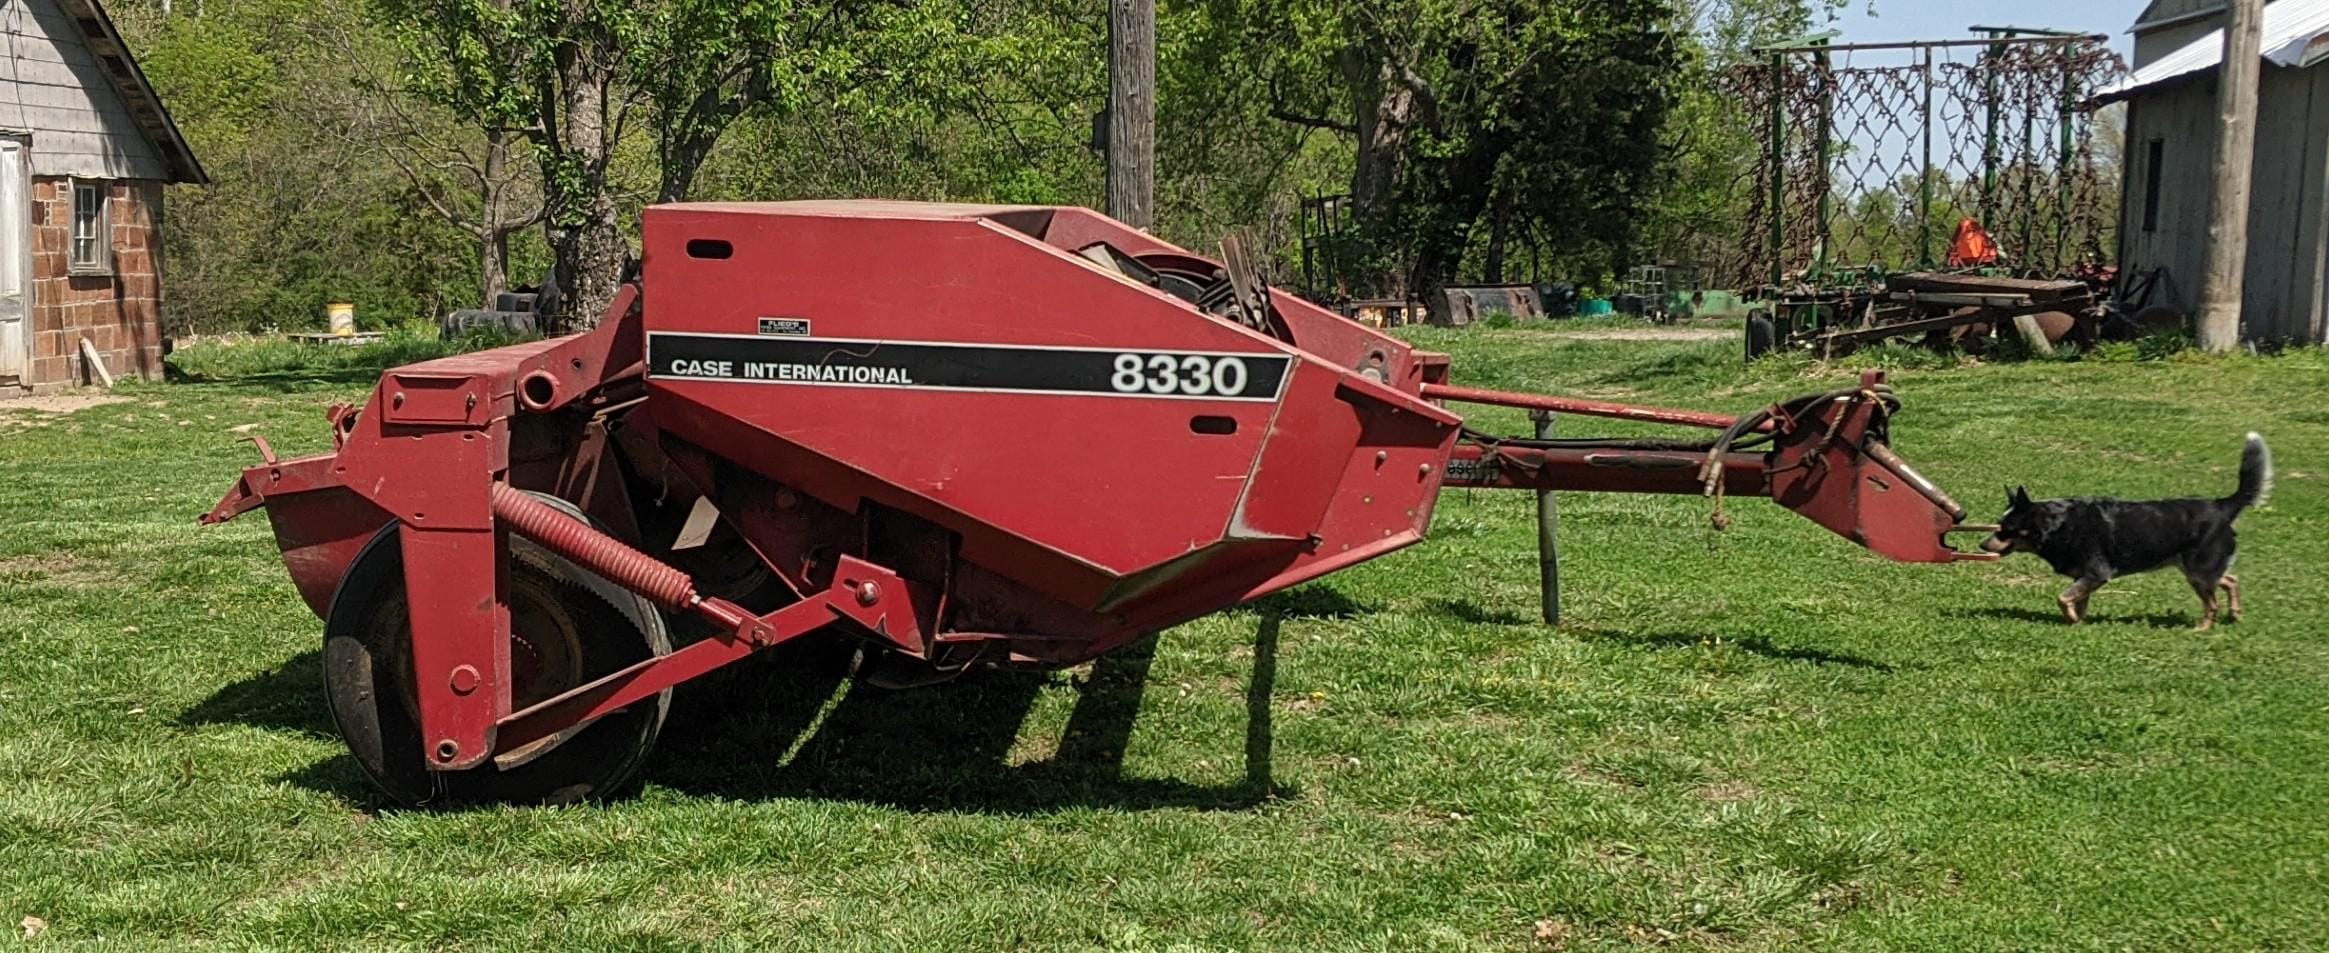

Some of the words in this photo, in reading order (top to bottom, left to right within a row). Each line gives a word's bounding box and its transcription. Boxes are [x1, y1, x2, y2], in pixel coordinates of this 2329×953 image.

[671, 359, 733, 377] CASE
[744, 362, 912, 384] INTERNATIONAL
[1111, 353, 1247, 396] 8330
